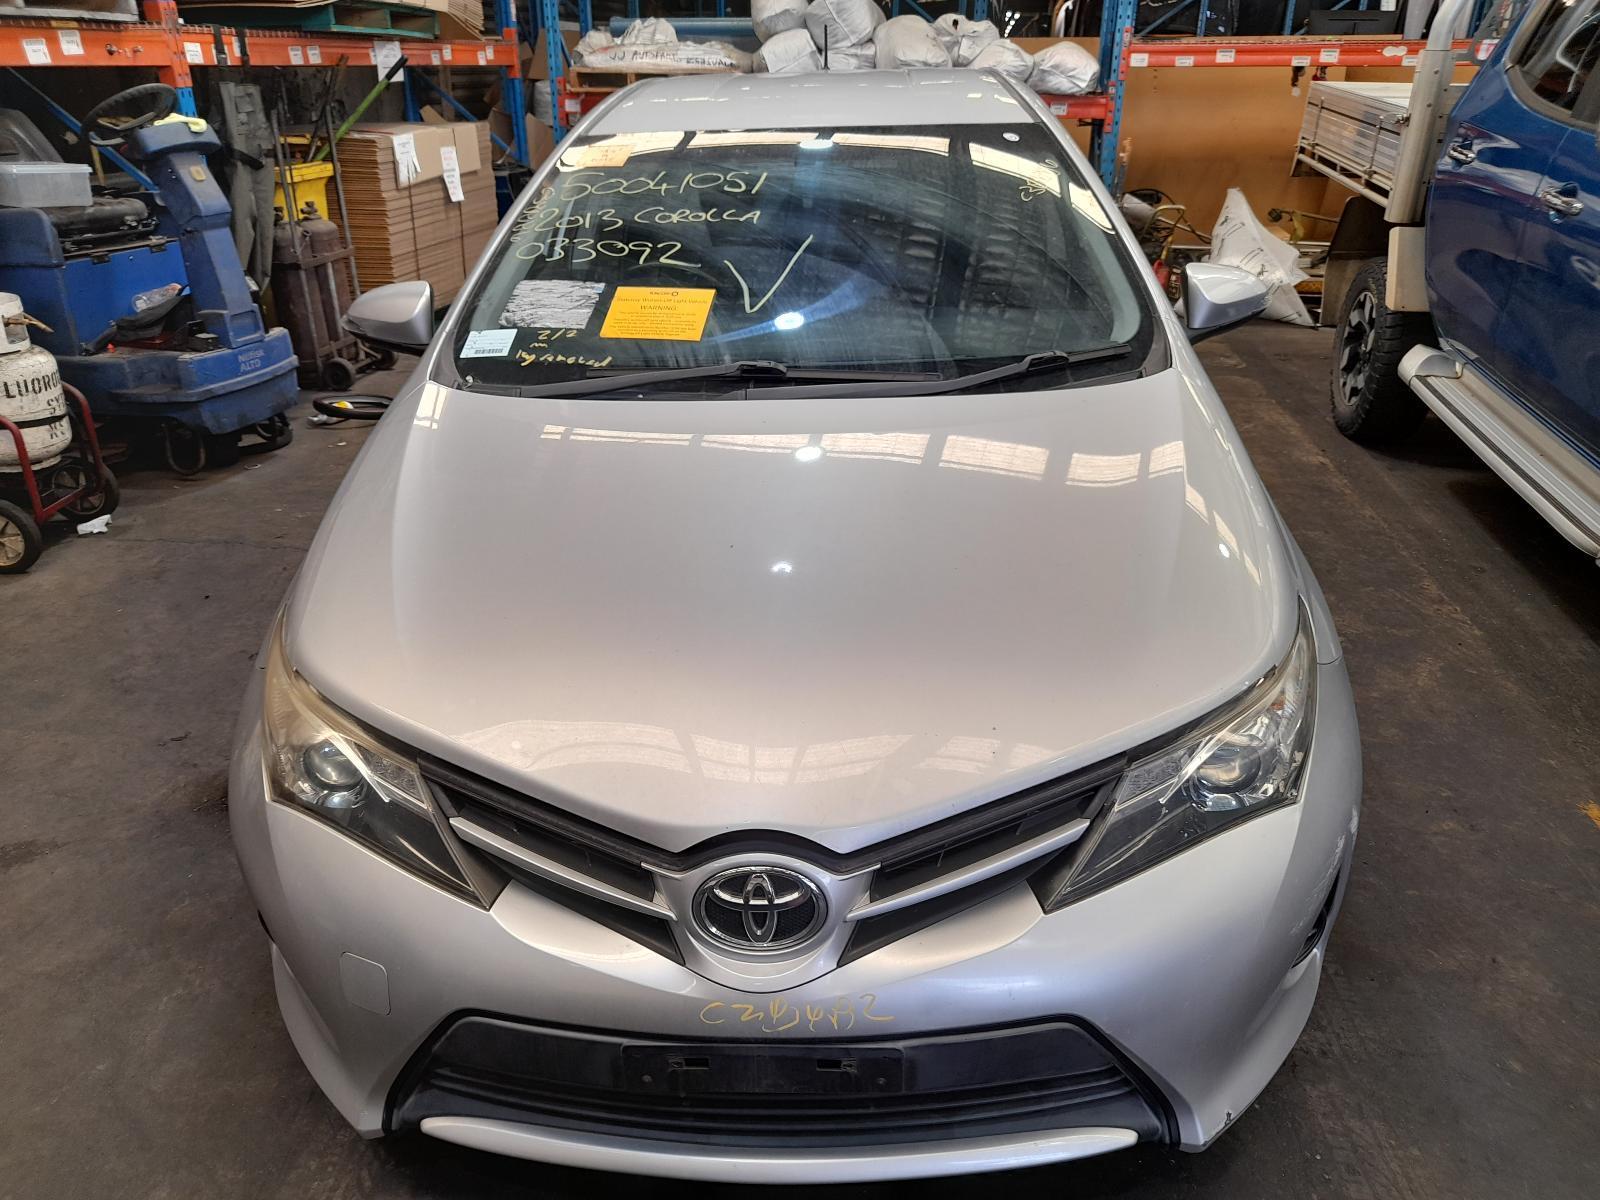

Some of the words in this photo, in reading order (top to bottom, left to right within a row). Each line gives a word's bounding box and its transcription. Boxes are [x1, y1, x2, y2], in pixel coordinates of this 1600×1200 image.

[560, 171, 768, 201] 50041051
[534, 208, 624, 232] 2013
[516, 237, 702, 268] 033092
